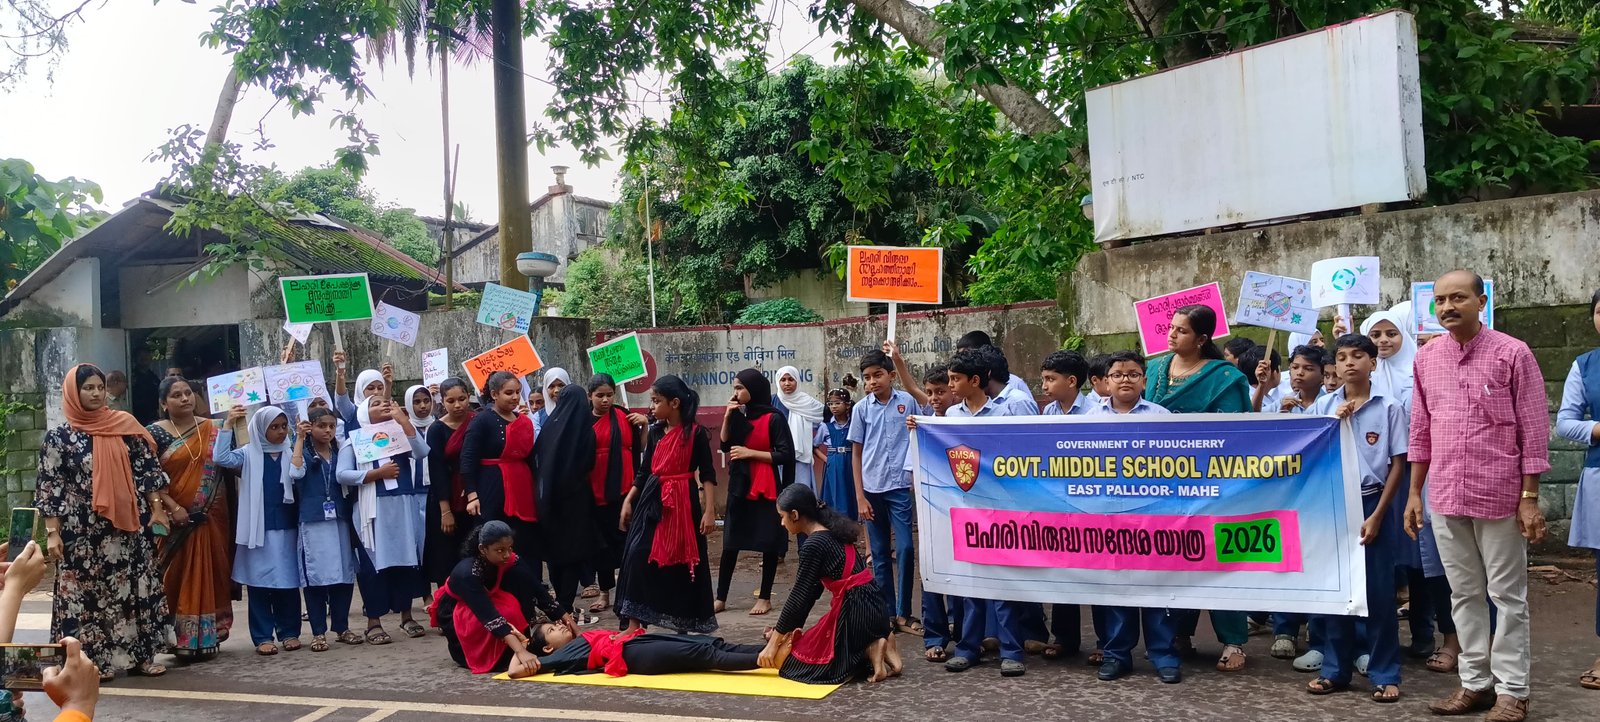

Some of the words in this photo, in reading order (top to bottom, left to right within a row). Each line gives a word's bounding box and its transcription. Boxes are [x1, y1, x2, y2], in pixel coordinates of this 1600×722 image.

[1131, 173, 1145, 181] NTC
[859, 250, 882, 263] ലഹരി
[289, 279, 318, 291] ലഹരി
[1147, 297, 1170, 315] ലഹരി
[474, 353, 496, 370] Just
[496, 347, 514, 358] Say
[744, 345, 774, 361] वीविंग
[777, 344, 796, 360] मिल
[481, 366, 492, 377] no
[492, 361, 504, 370] to
[1056, 440, 1128, 449] GOVERNMENT
[1131, 440, 1146, 449] OF
[1149, 439, 1226, 449] PUDUCHERRY
[949, 451, 975, 459] GMSA
[993, 455, 1047, 478] GOVT.
[1048, 455, 1118, 478] MIDDLE
[1122, 455, 1202, 479] SCHOOL
[1206, 453, 1302, 478] AVAROTH
[1068, 484, 1102, 495] EAST
[1106, 485, 1174, 496] PALLOOR-
[1178, 485, 1219, 497] MAHE
[964, 520, 1019, 550] ലഹരി
[1020, 519, 1081, 553] വിരുദ്ധ
[1083, 527, 1152, 556] സന്ദേശ
[1153, 529, 1206, 562] യാത്ര
[1220, 523, 1276, 556] 2026
